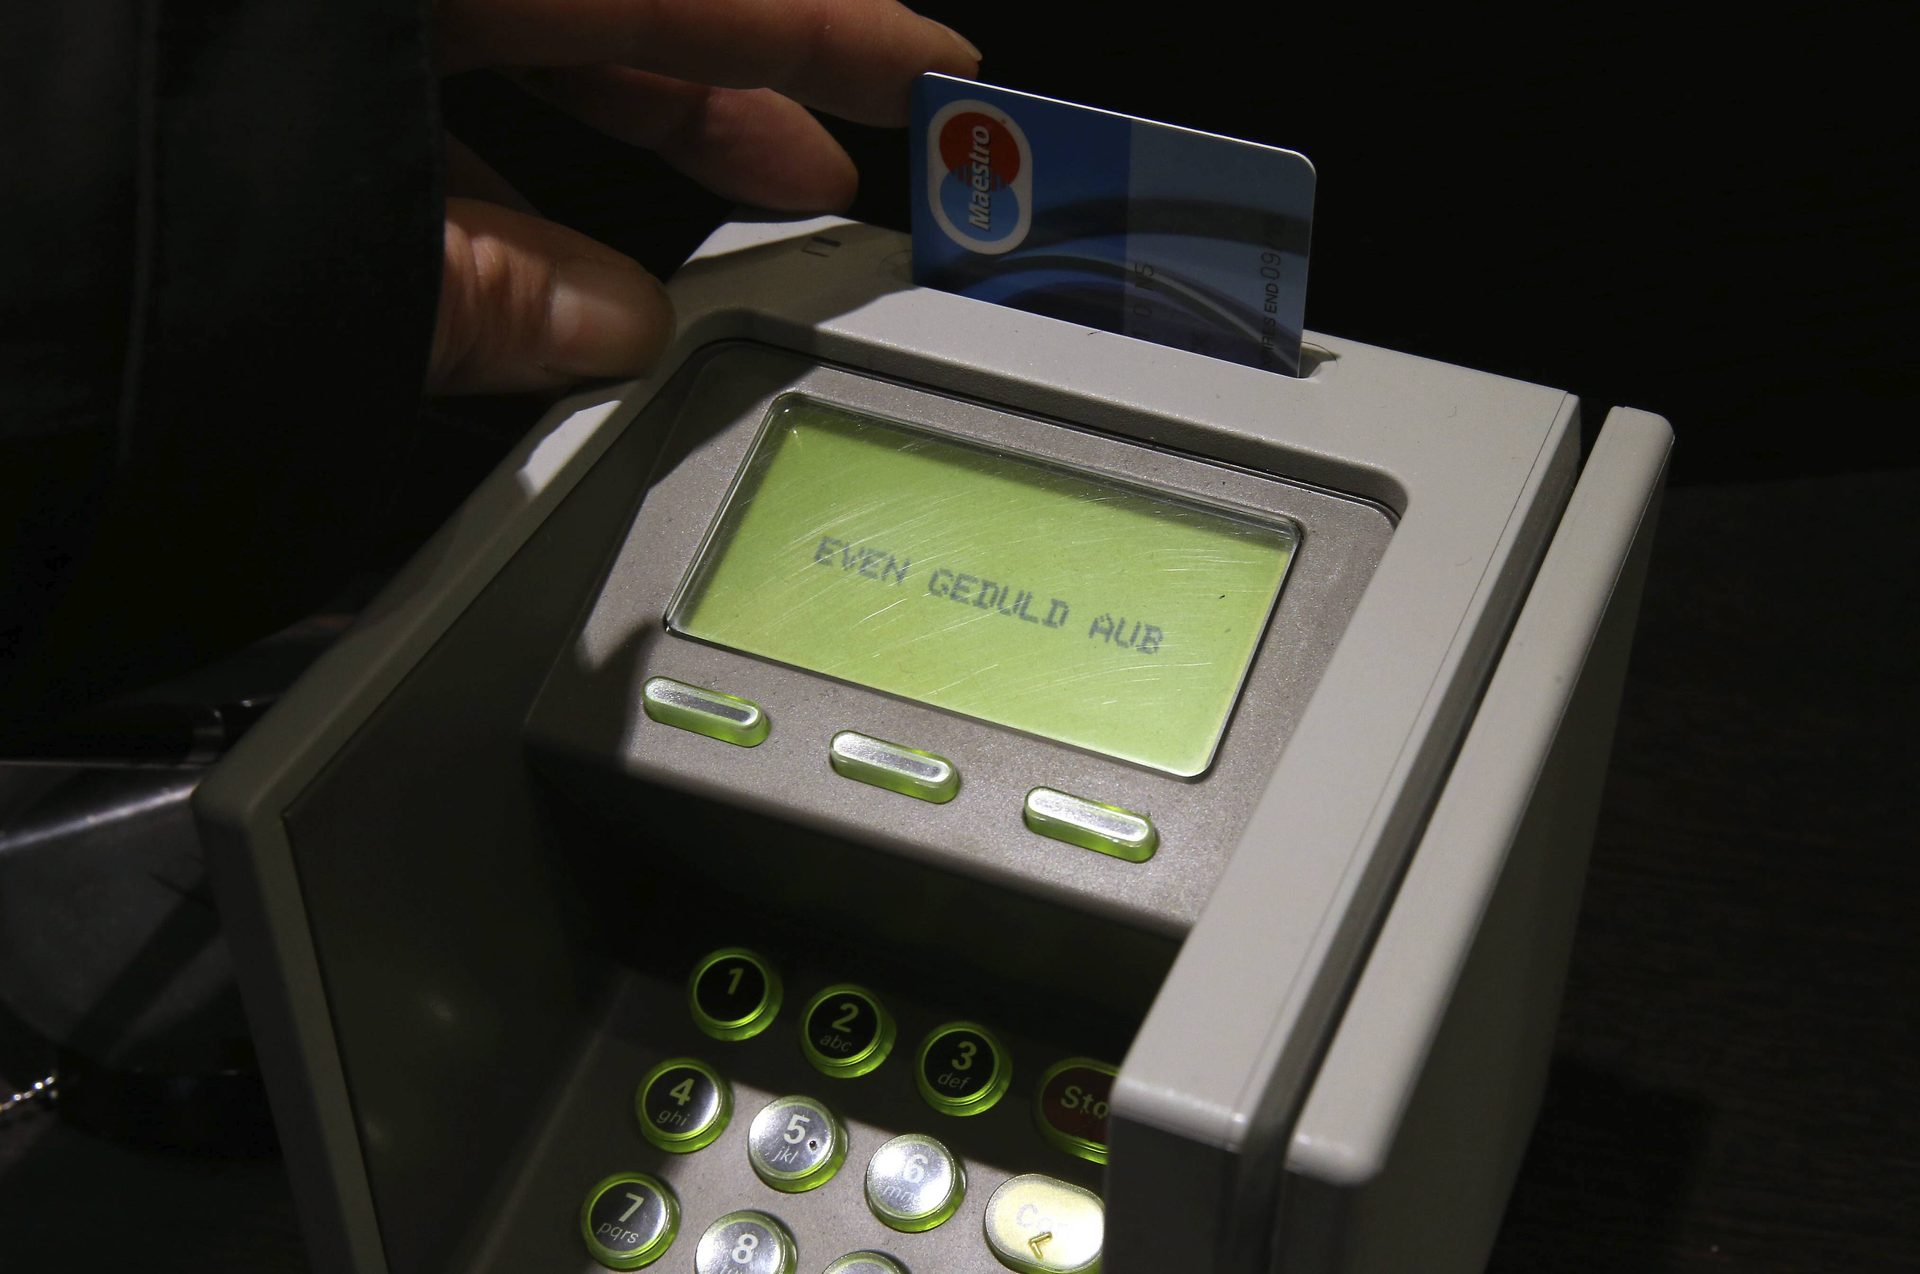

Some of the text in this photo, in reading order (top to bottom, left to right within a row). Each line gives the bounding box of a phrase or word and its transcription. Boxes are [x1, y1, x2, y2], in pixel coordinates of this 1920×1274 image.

[968, 125, 992, 233] Maestro
[1264, 283, 1280, 314] END
[813, 536, 1164, 654] EVEN GEDULD AUB
[726, 967, 744, 995] 1
[833, 1003, 860, 1033] 2
[819, 1034, 853, 1053] abc
[951, 1041, 977, 1071] 3
[669, 1077, 695, 1106] 4
[937, 1070, 969, 1091] def
[656, 1107, 692, 1128] ghi
[1061, 1086, 1109, 1119] Sto
[784, 1114, 809, 1144] 5
[772, 1145, 798, 1165] jkl
[903, 1154, 929, 1184] 6
[618, 1193, 645, 1223] 7
[597, 1220, 640, 1245] pqrs
[731, 1233, 759, 1264] 8
